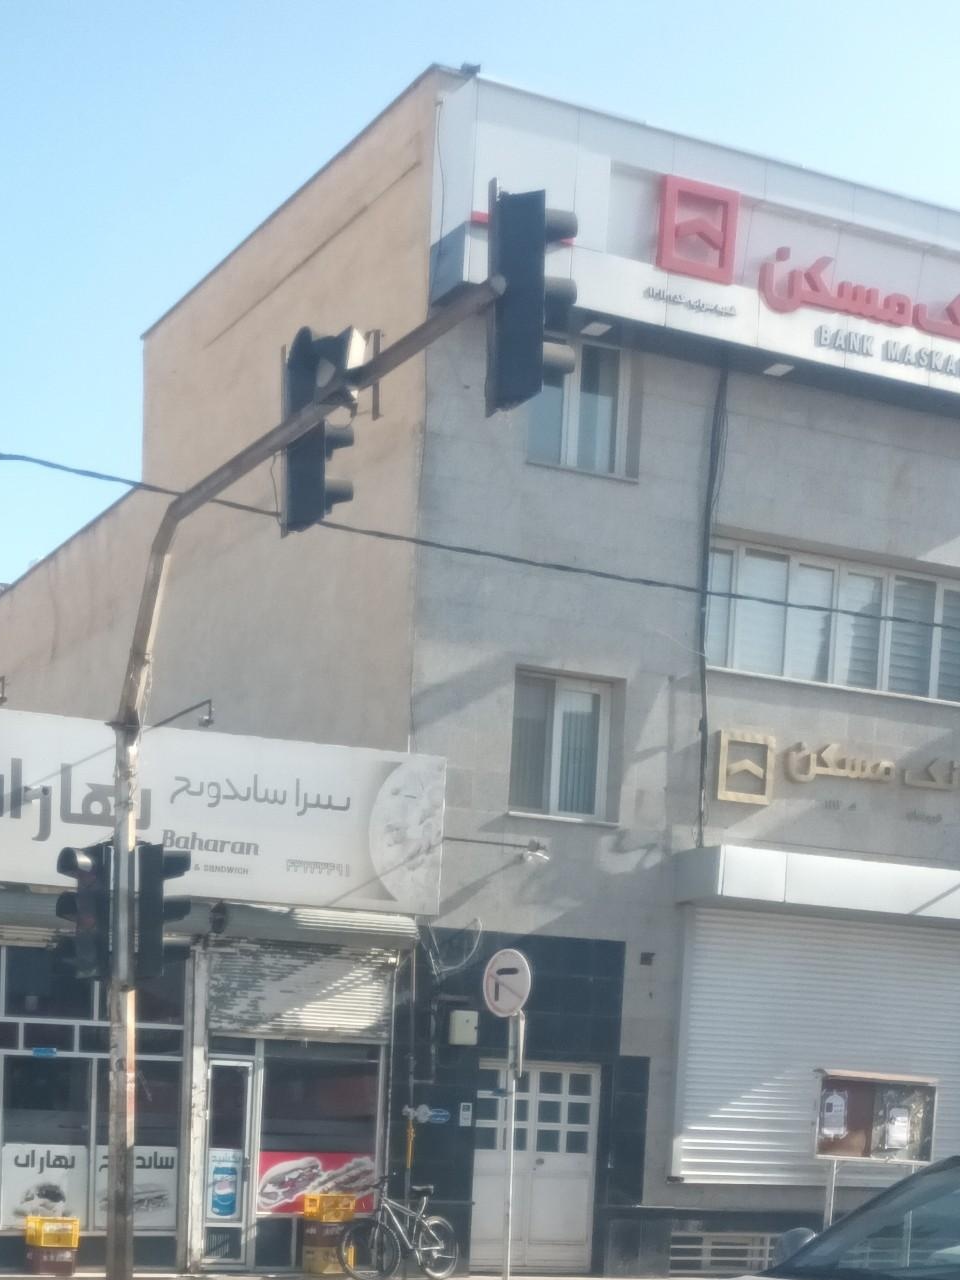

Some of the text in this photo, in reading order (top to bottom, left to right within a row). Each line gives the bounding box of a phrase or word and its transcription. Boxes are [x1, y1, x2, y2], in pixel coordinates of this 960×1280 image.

[758, 246, 914, 327] مسکن
[815, 325, 960, 378] BANK MASKA
[784, 742, 896, 783] مسکن
[162, 829, 260, 856] Baharan
